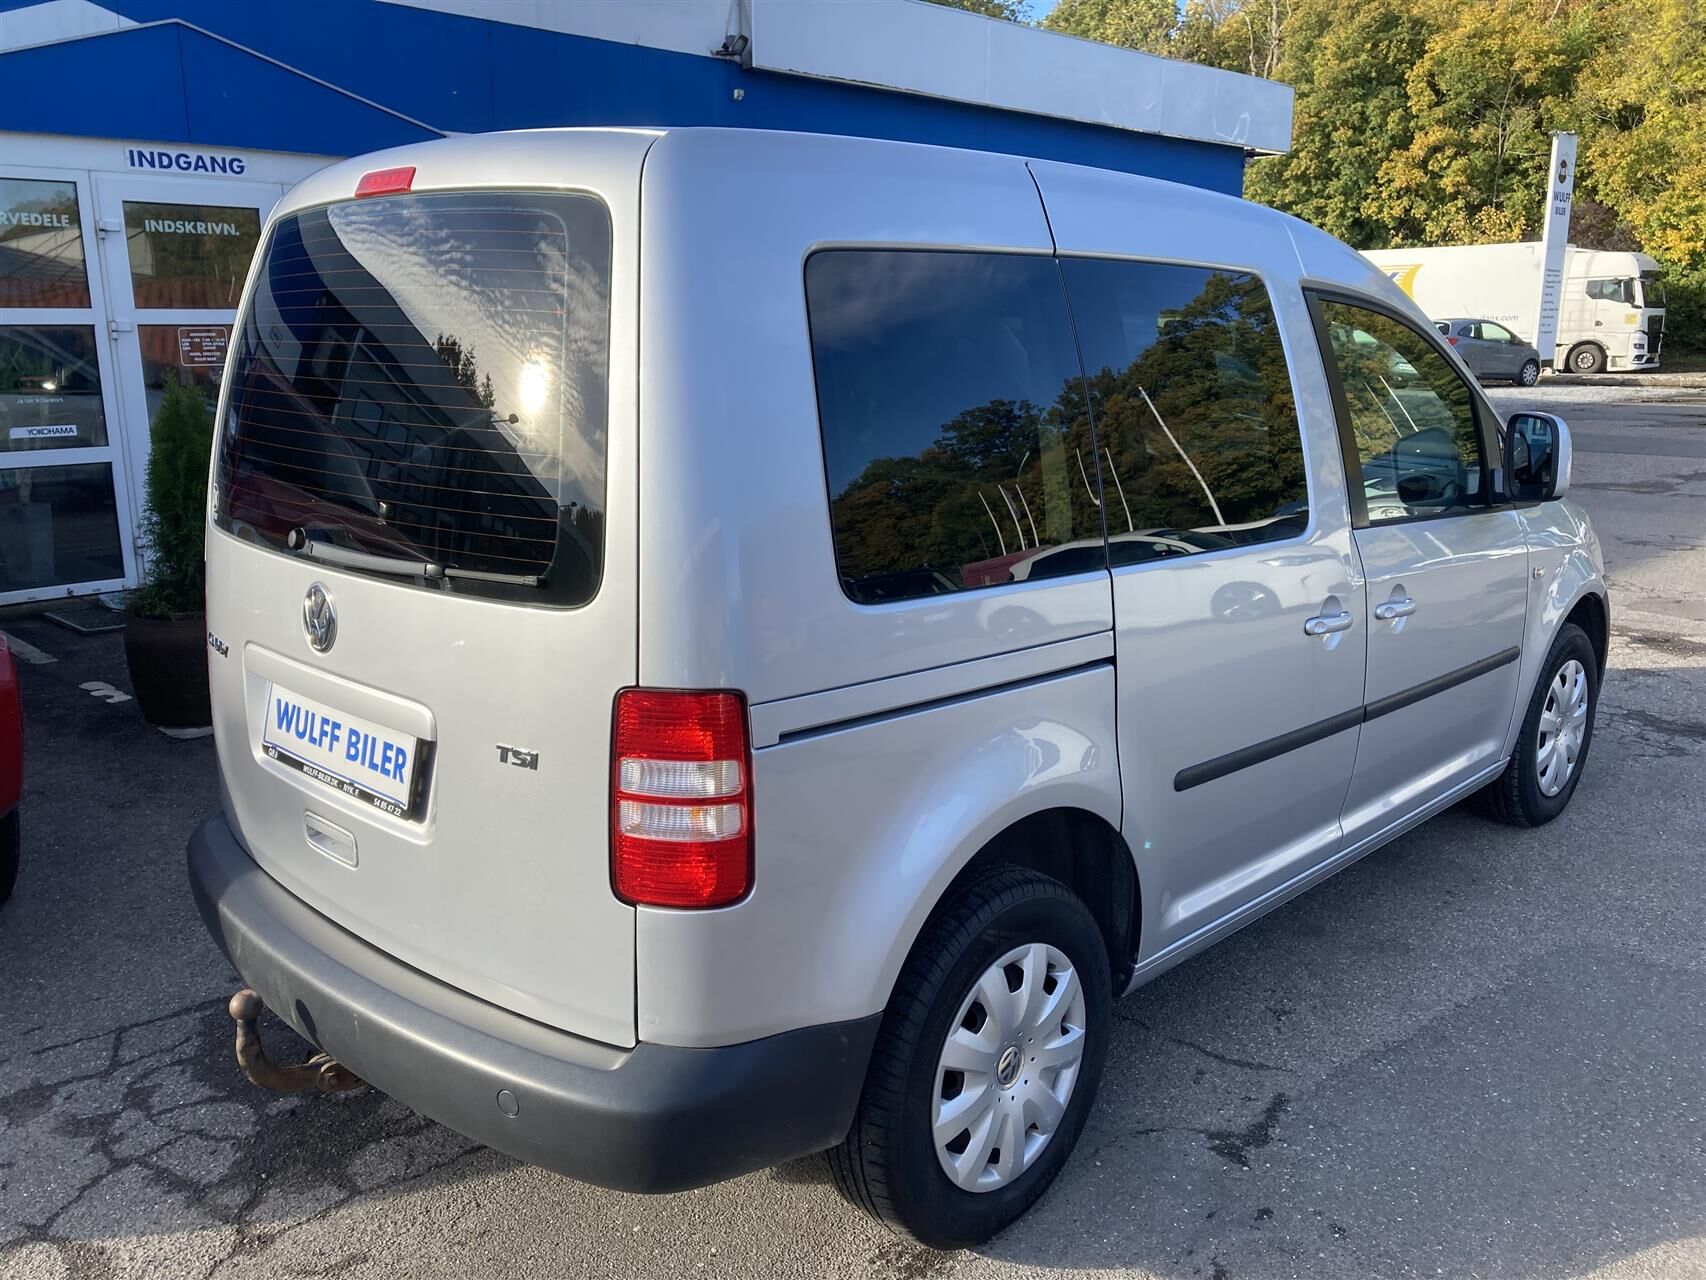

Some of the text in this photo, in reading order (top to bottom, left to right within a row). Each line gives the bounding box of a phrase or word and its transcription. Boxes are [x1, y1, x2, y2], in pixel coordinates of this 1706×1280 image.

[128, 149, 246, 175] INDGANG
[1553, 191, 1572, 203] WULFF
[0, 211, 70, 228] RVEDELE
[1554, 206, 1567, 216] BILER
[144, 219, 240, 237] INDSKRIVN.
[26, 427, 75, 436] YOKOHAMA
[276, 698, 407, 785] WULFF BILER
[495, 743, 539, 771] TSI
[373, 797, 380, 807] 54
[394, 807, 401, 816] 22
